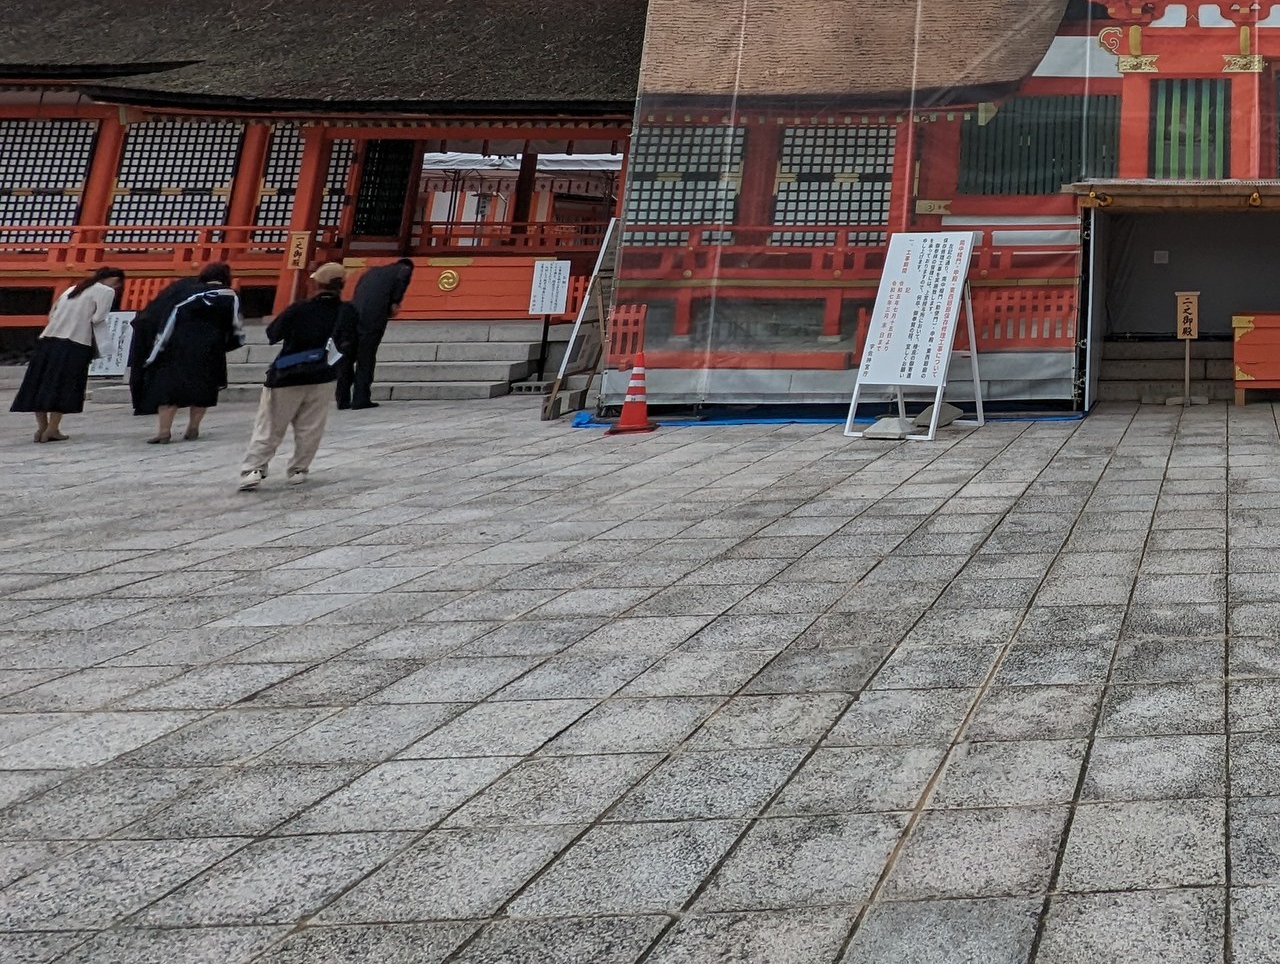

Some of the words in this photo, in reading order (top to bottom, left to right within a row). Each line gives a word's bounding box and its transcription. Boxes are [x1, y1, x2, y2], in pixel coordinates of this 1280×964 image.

[292, 237, 305, 267] 一之御殿
[1182, 297, 1193, 336] 二之御殿
